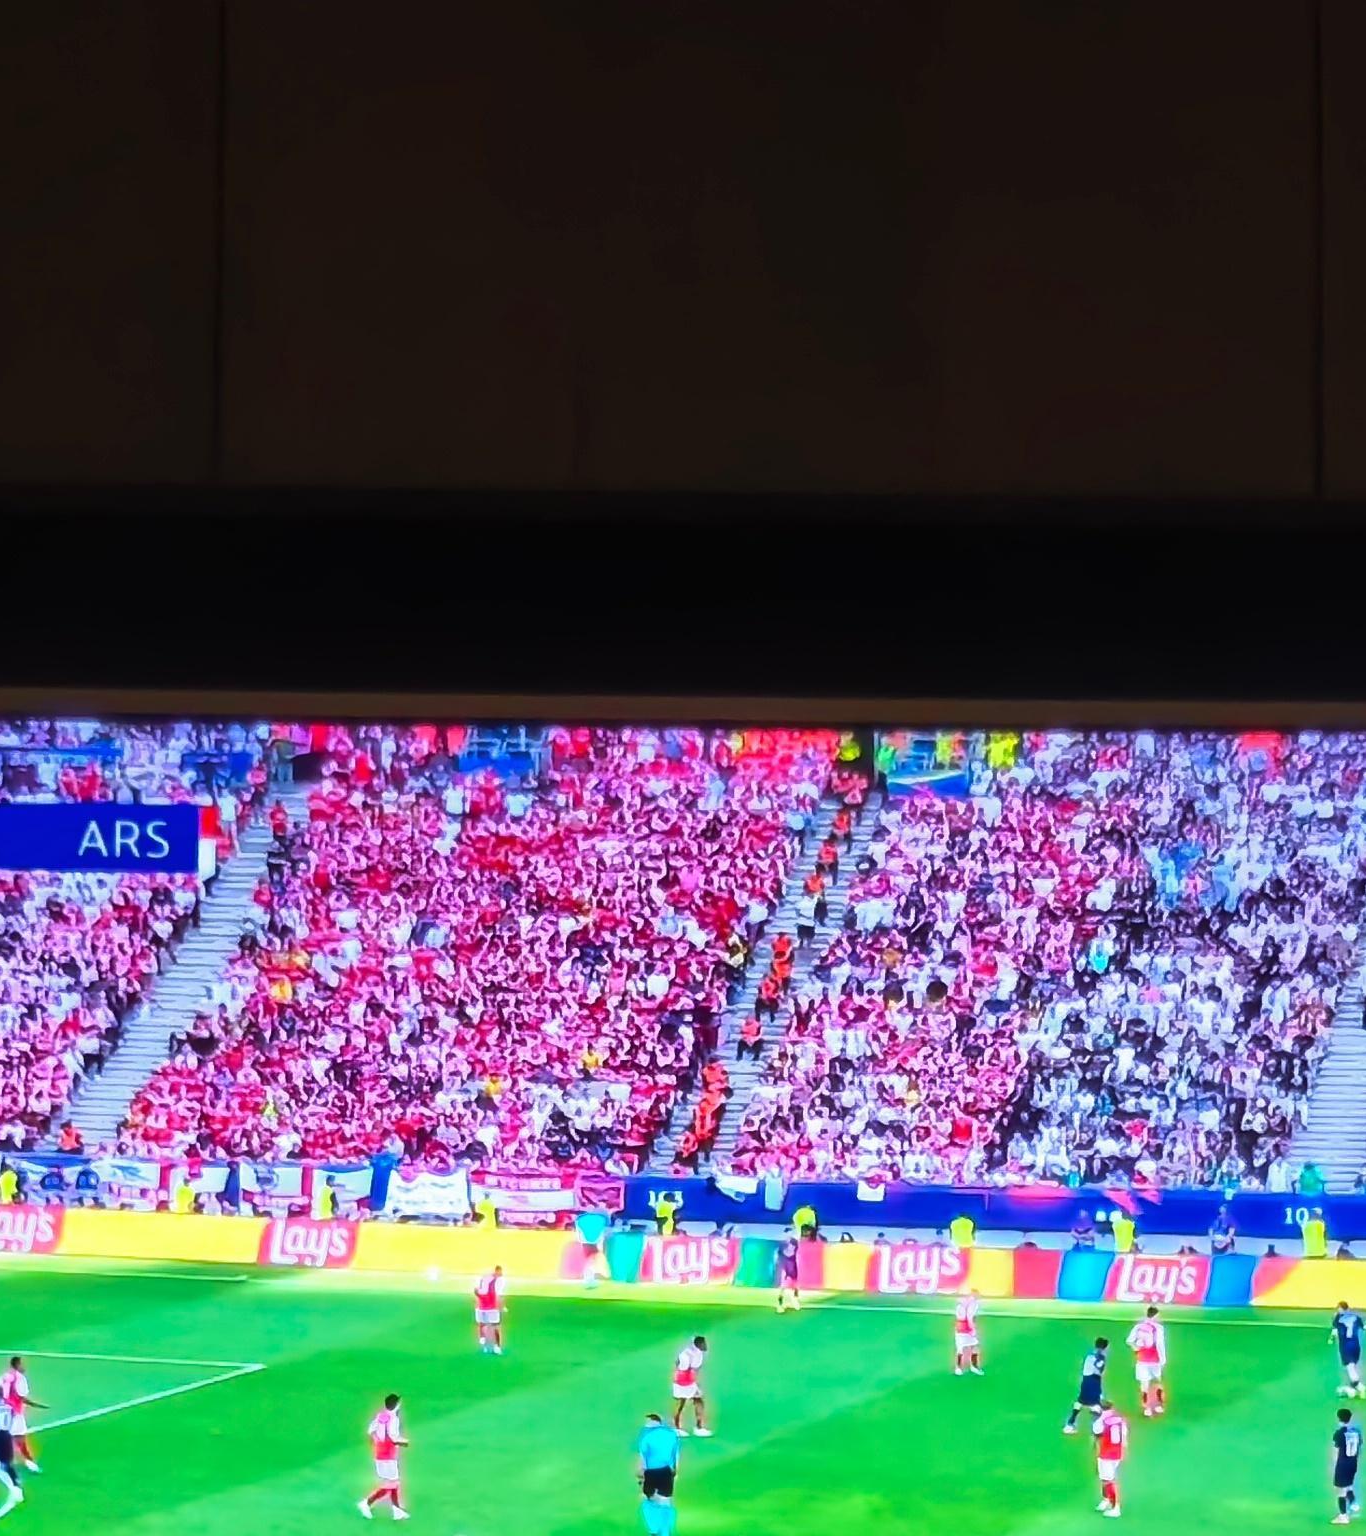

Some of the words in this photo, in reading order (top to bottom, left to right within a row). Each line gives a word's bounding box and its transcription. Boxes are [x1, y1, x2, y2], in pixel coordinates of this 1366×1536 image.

[78, 820, 171, 859] ARS
[270, 1217, 348, 1267] Lay's
[1115, 1254, 1197, 1303] Lay's
